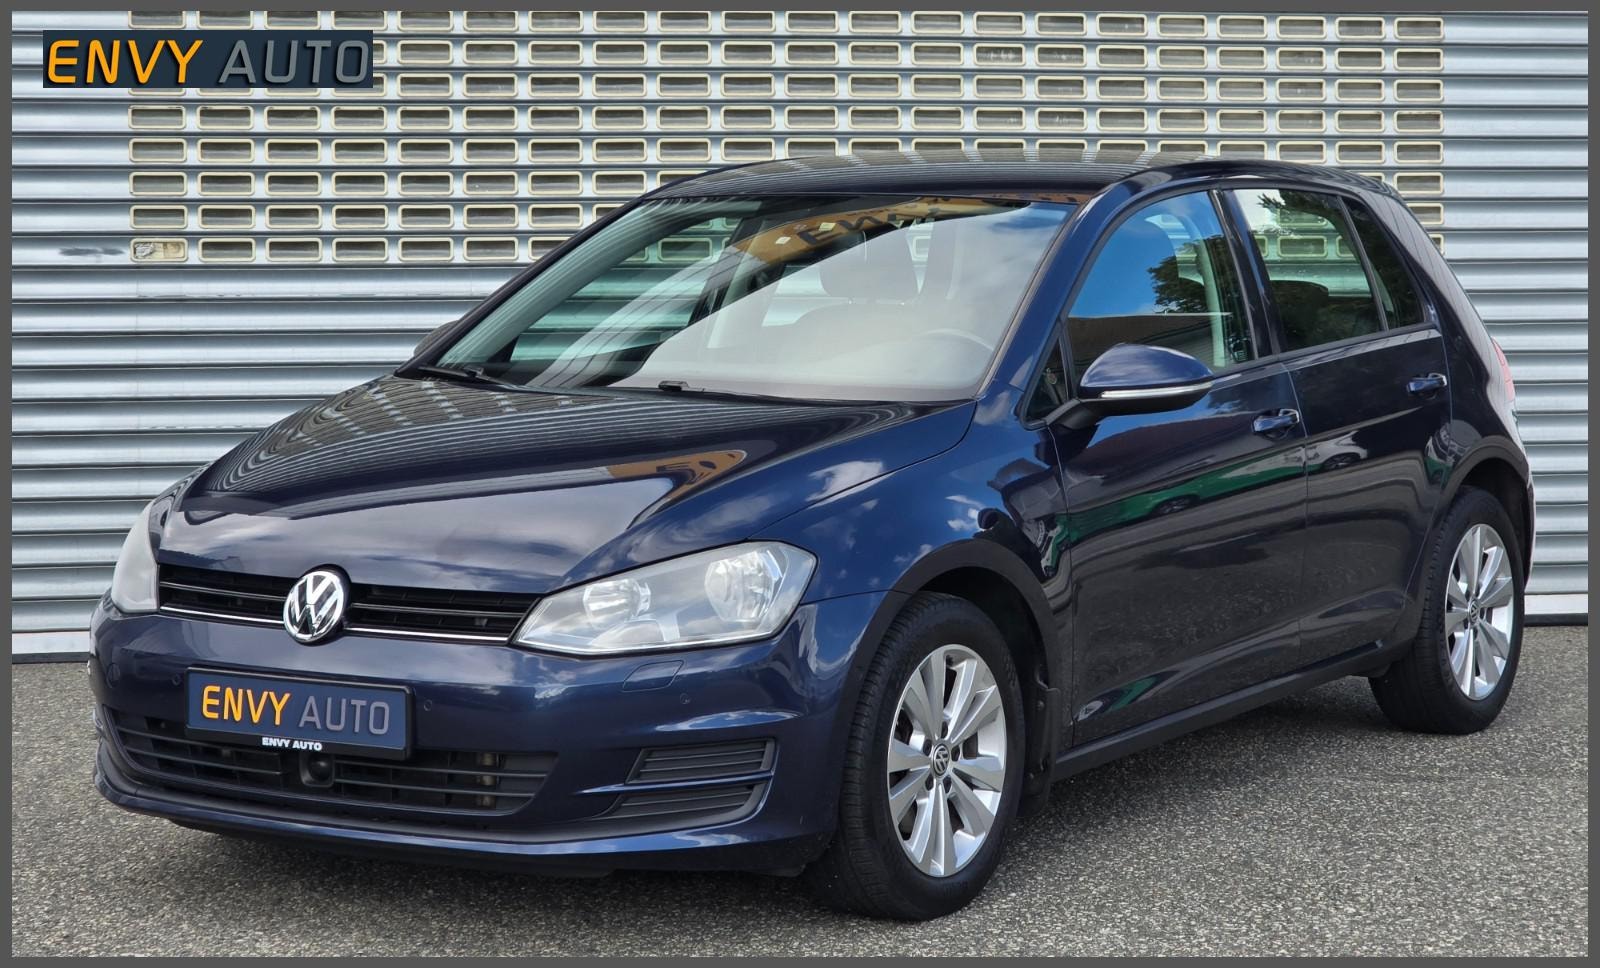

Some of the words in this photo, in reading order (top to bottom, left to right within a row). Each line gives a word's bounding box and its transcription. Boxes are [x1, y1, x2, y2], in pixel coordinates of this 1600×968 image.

[202, 685, 292, 726] ENVY
[299, 695, 390, 736] AUTO
[261, 736, 291, 748] ENVY
[292, 740, 323, 752] AUTO
